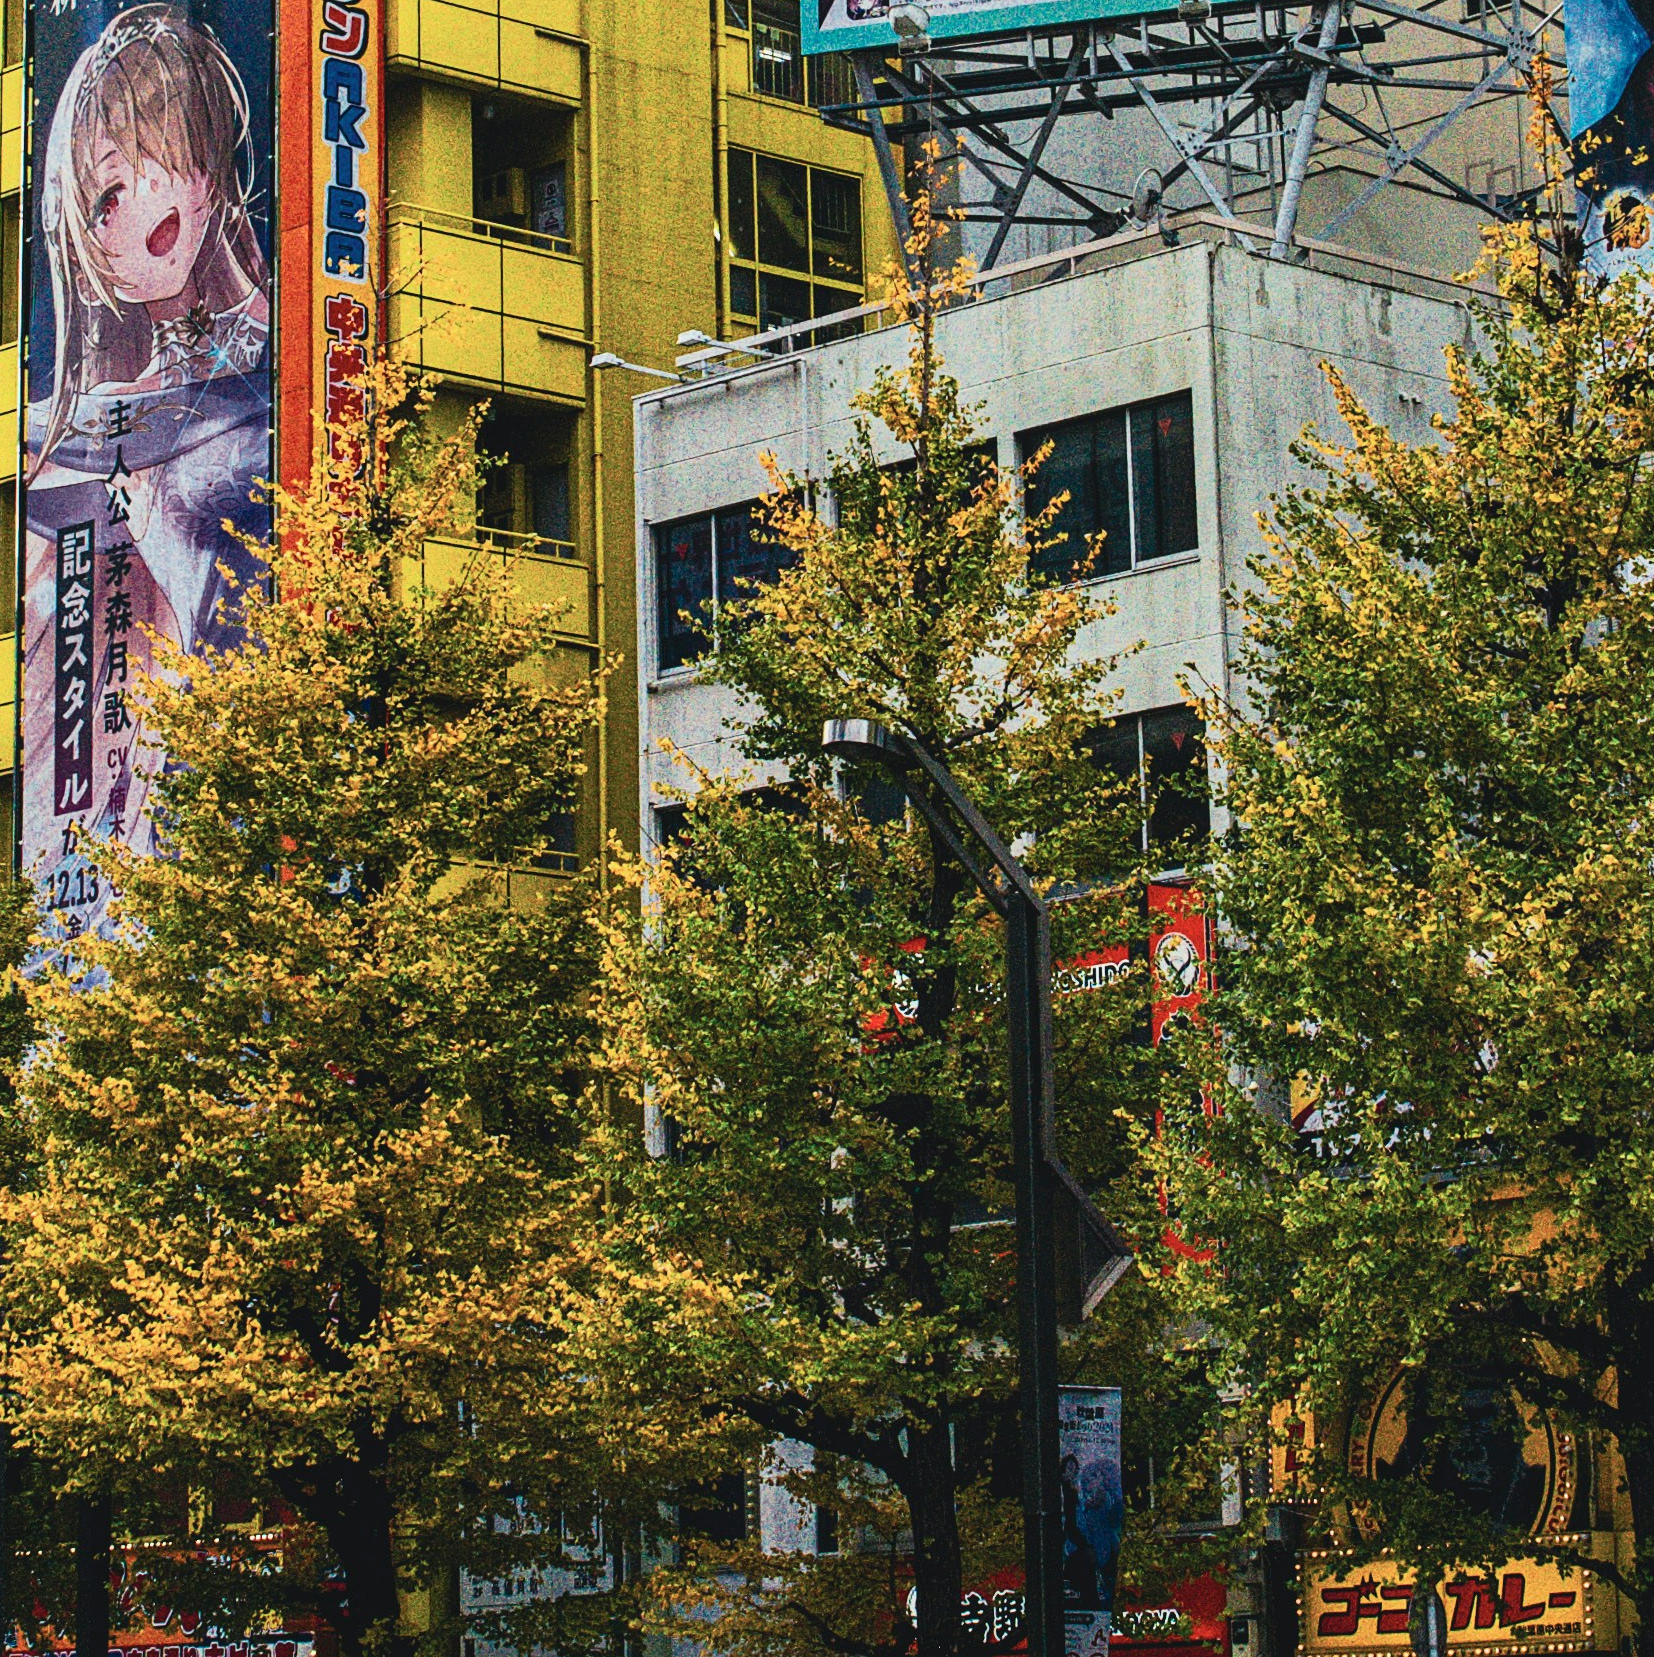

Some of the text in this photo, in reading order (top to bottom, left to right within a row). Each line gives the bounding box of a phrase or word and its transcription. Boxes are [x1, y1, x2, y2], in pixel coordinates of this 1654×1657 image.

[322, 60, 367, 280] AKIBA
[103, 399, 134, 734] 主人公 茅森月歌
